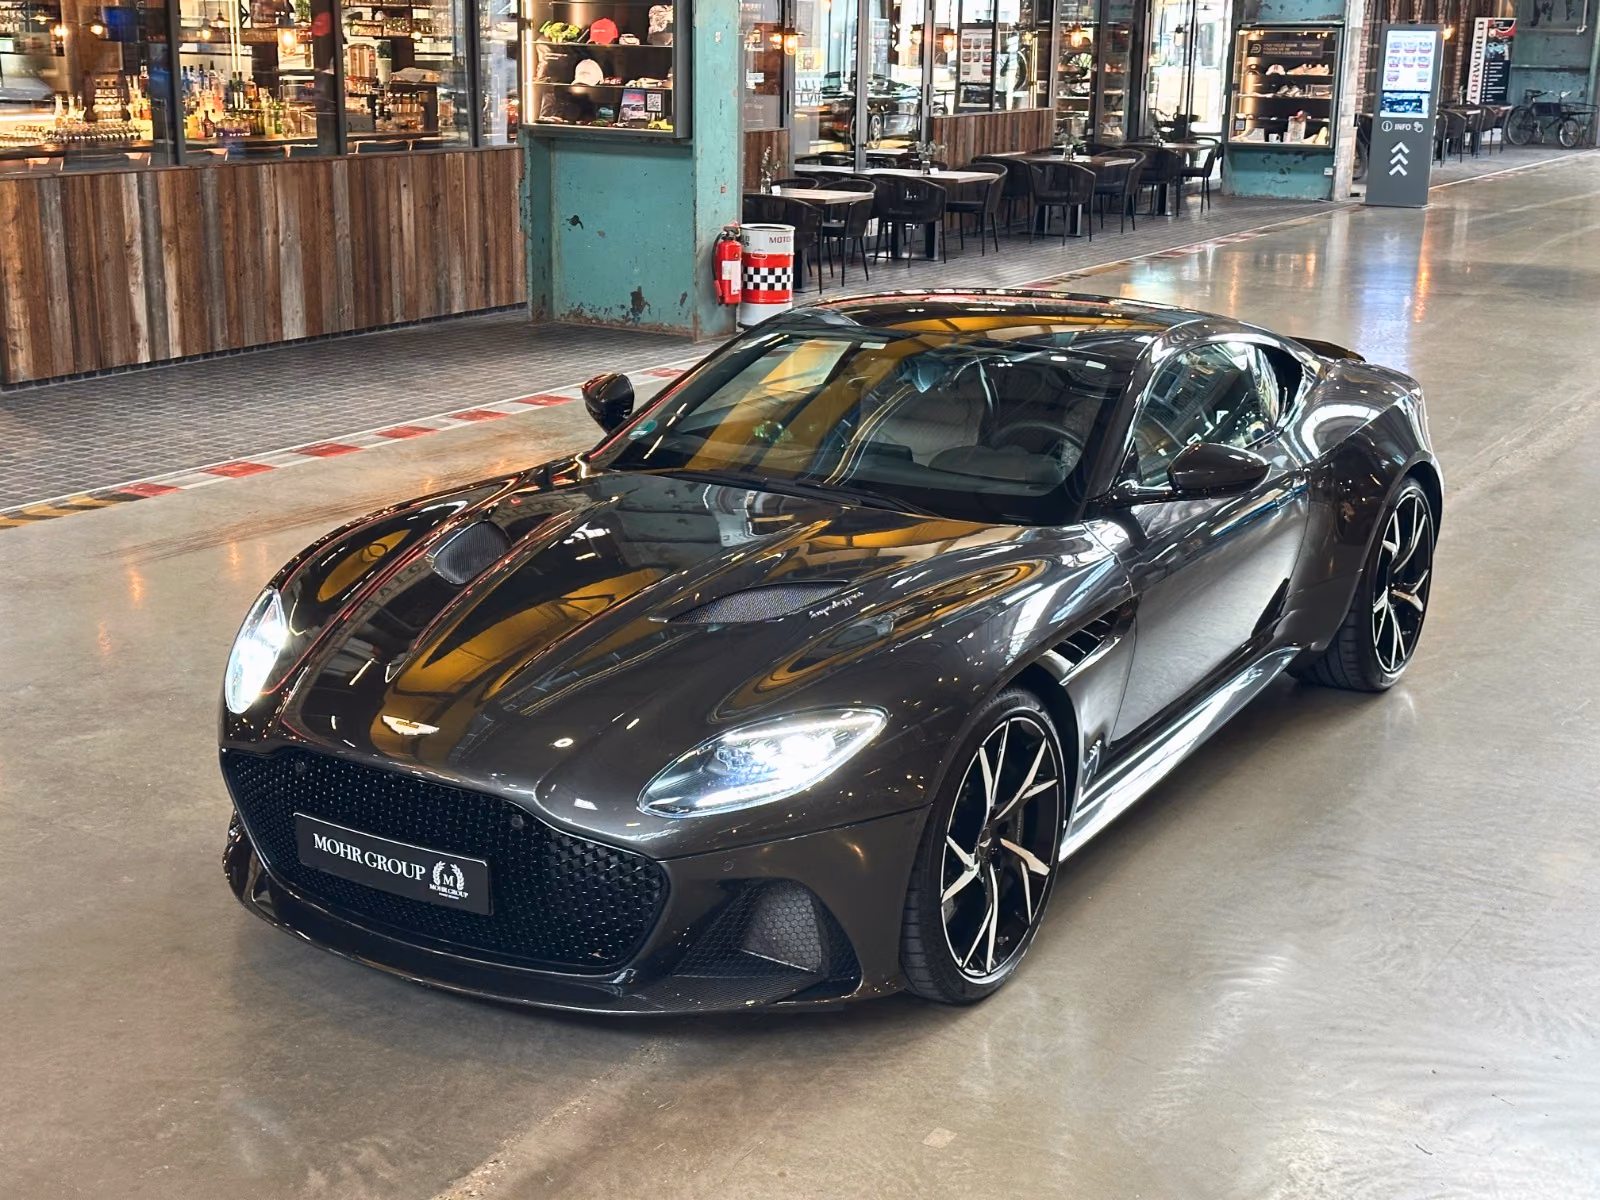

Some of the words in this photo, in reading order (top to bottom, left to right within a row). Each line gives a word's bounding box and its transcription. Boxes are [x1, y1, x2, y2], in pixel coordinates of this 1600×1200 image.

[1394, 123, 1412, 131] INFO
[312, 833, 364, 864] MOHR
[364, 851, 426, 880] GROUP
[442, 873, 454, 887] M
[429, 883, 448, 894] MOHR
[447, 888, 469, 899] GROUP
